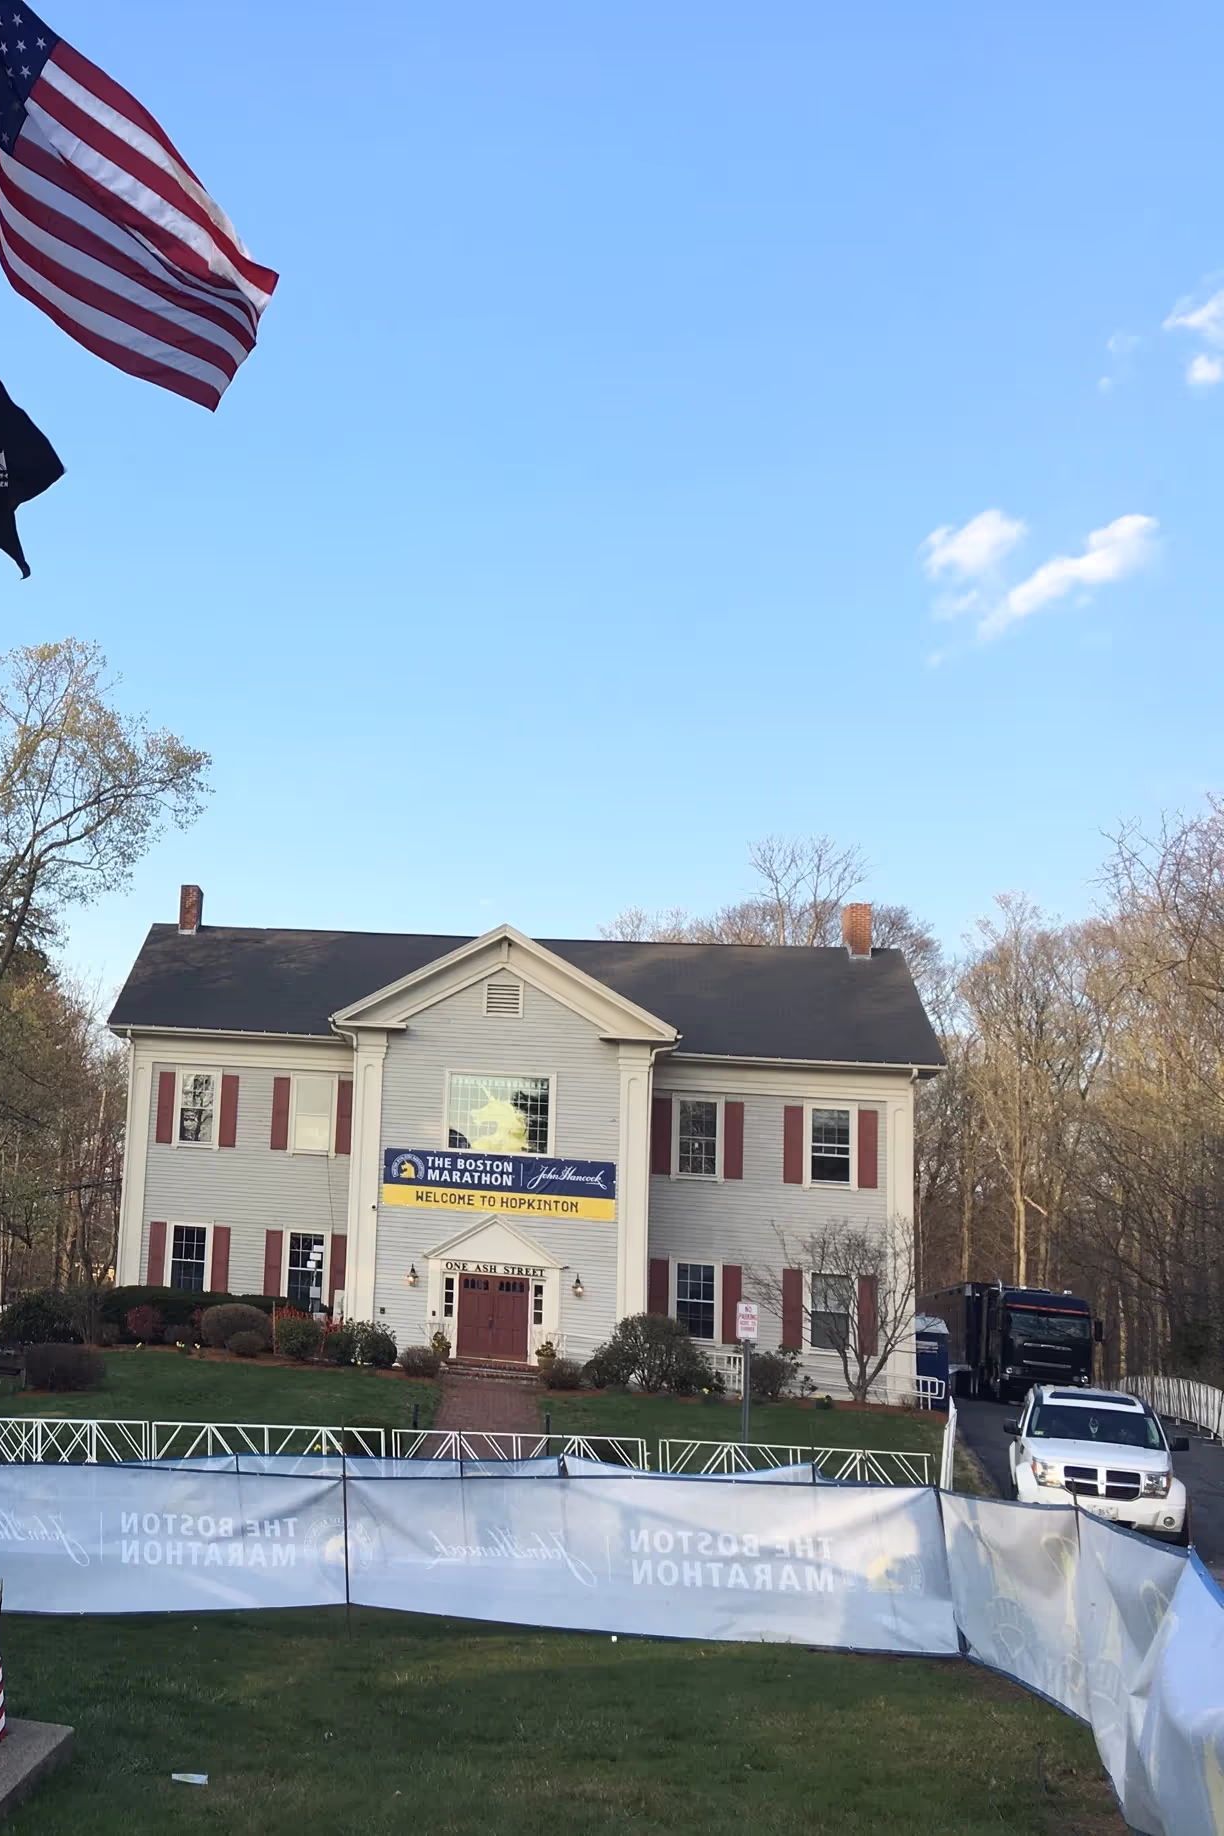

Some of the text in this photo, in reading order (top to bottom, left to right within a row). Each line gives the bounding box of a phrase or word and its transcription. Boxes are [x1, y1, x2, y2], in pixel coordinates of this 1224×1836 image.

[427, 1156, 452, 1169] THE
[457, 1158, 513, 1173] BOSTON
[427, 1169, 513, 1187] MARATHON
[526, 1164, 608, 1190] John Hancock
[415, 1190, 579, 1213] WELCOME TO HOPKINTON
[446, 1262, 546, 1278] ONE ASH STREET
